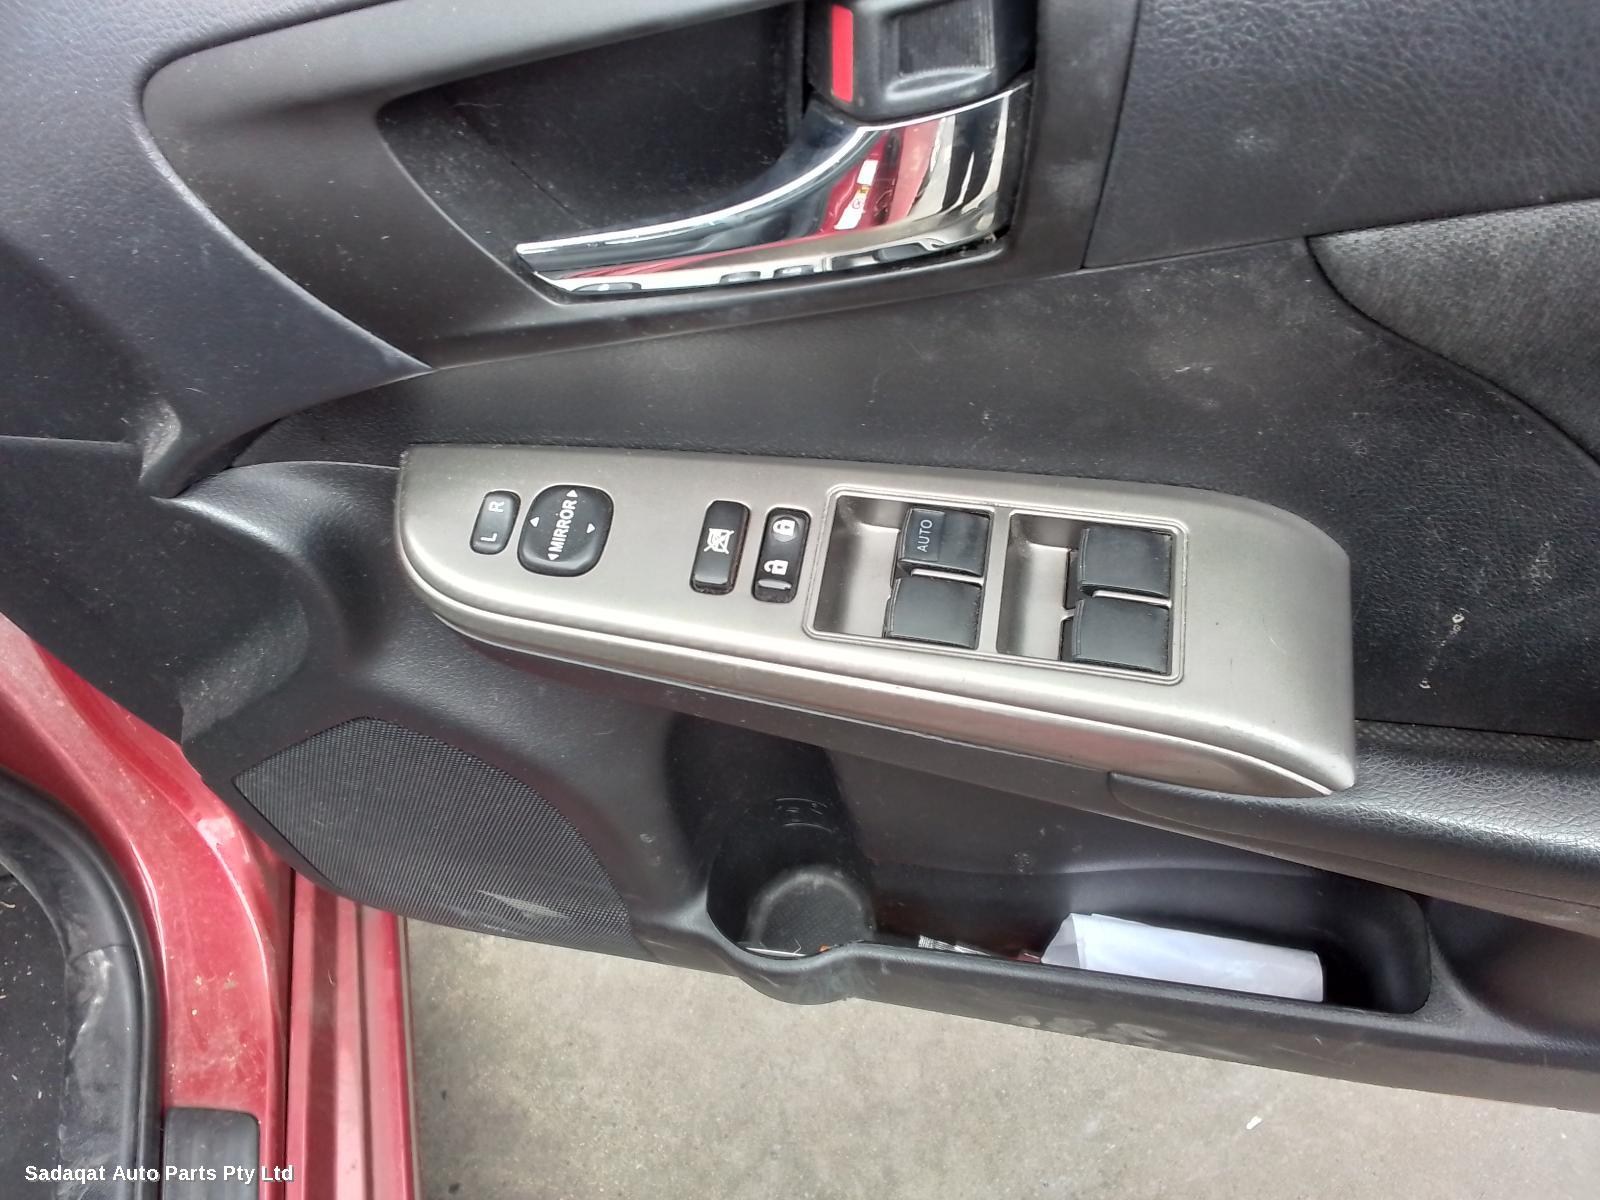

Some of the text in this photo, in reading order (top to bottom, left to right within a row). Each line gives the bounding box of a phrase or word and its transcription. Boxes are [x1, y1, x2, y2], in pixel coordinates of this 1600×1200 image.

[488, 501, 505, 513] R
[481, 533, 498, 542] L
[548, 500, 578, 553] MIRROR
[917, 519, 933, 553] AUTO
